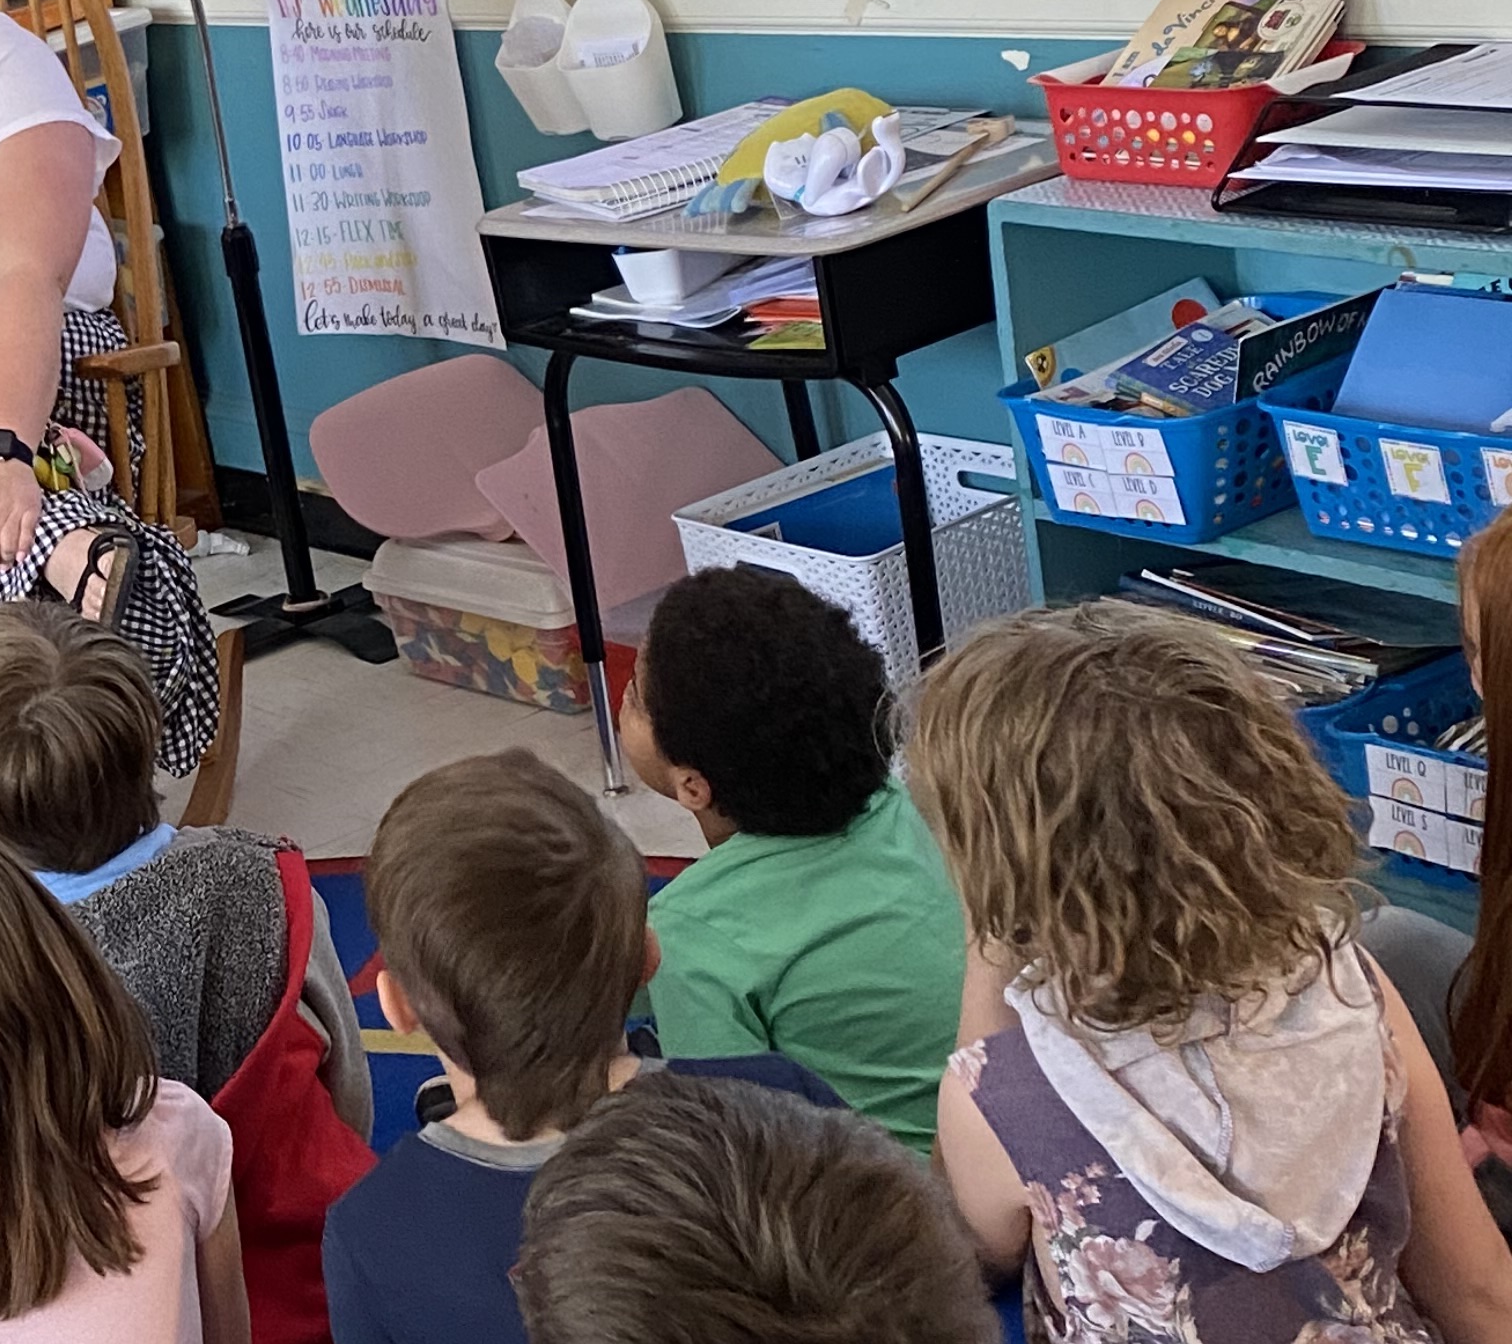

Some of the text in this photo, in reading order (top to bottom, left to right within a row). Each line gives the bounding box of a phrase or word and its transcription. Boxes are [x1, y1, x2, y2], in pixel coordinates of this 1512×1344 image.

[292, 18, 432, 43] here is our schedule
[340, 220, 375, 243] FLEX
[343, 304, 467, 335] make today a great
[1161, 343, 1204, 371] TALE
[1252, 311, 1356, 393] RAINBOW OF
[1192, 374, 1234, 398] DOG
[1052, 420, 1086, 439] LEVEL A
[1112, 431, 1136, 446] LEVEL
[1305, 445, 1326, 475] E
[1063, 470, 1086, 487] LEVEL
[1122, 477, 1157, 495] LEVEL D
[1403, 463, 1423, 492] F
[1386, 753, 1427, 777] LEVEL Q
[1391, 807, 1428, 831] LEVEL S
